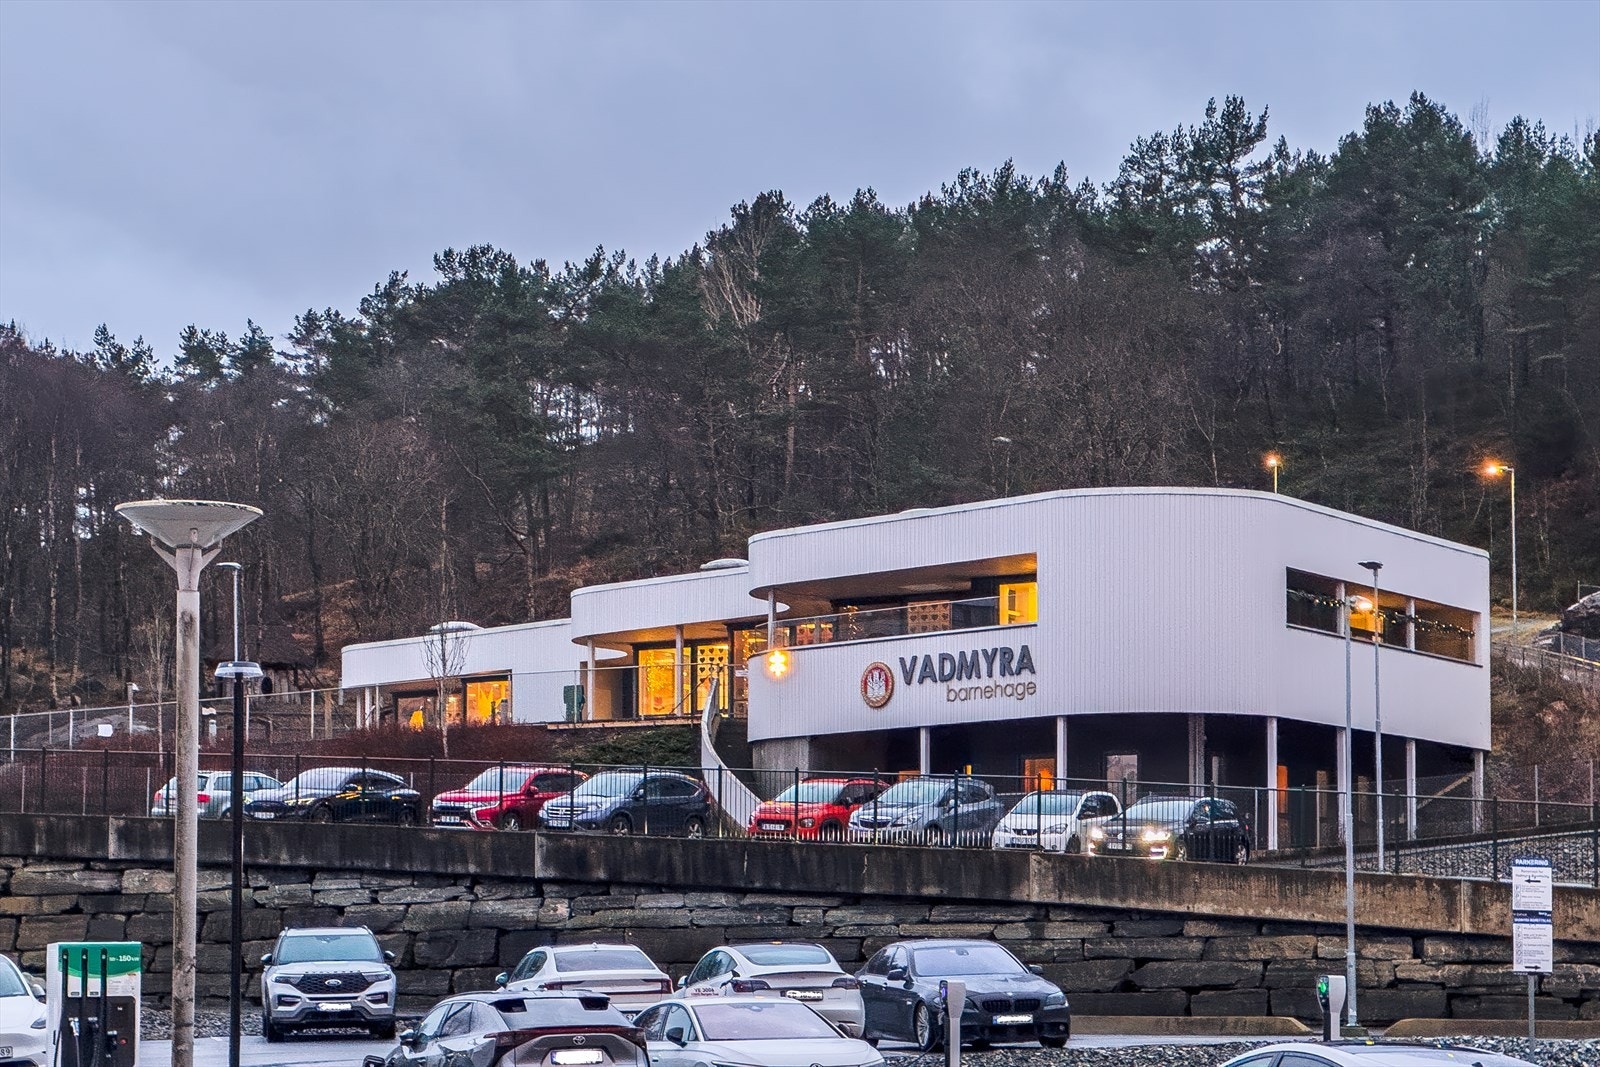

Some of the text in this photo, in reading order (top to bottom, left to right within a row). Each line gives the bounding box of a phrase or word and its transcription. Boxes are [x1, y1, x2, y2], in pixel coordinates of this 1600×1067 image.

[899, 645, 1036, 686] VADMYRA
[946, 680, 1037, 702] barnehage
[1515, 858, 1549, 866] PARKERING
